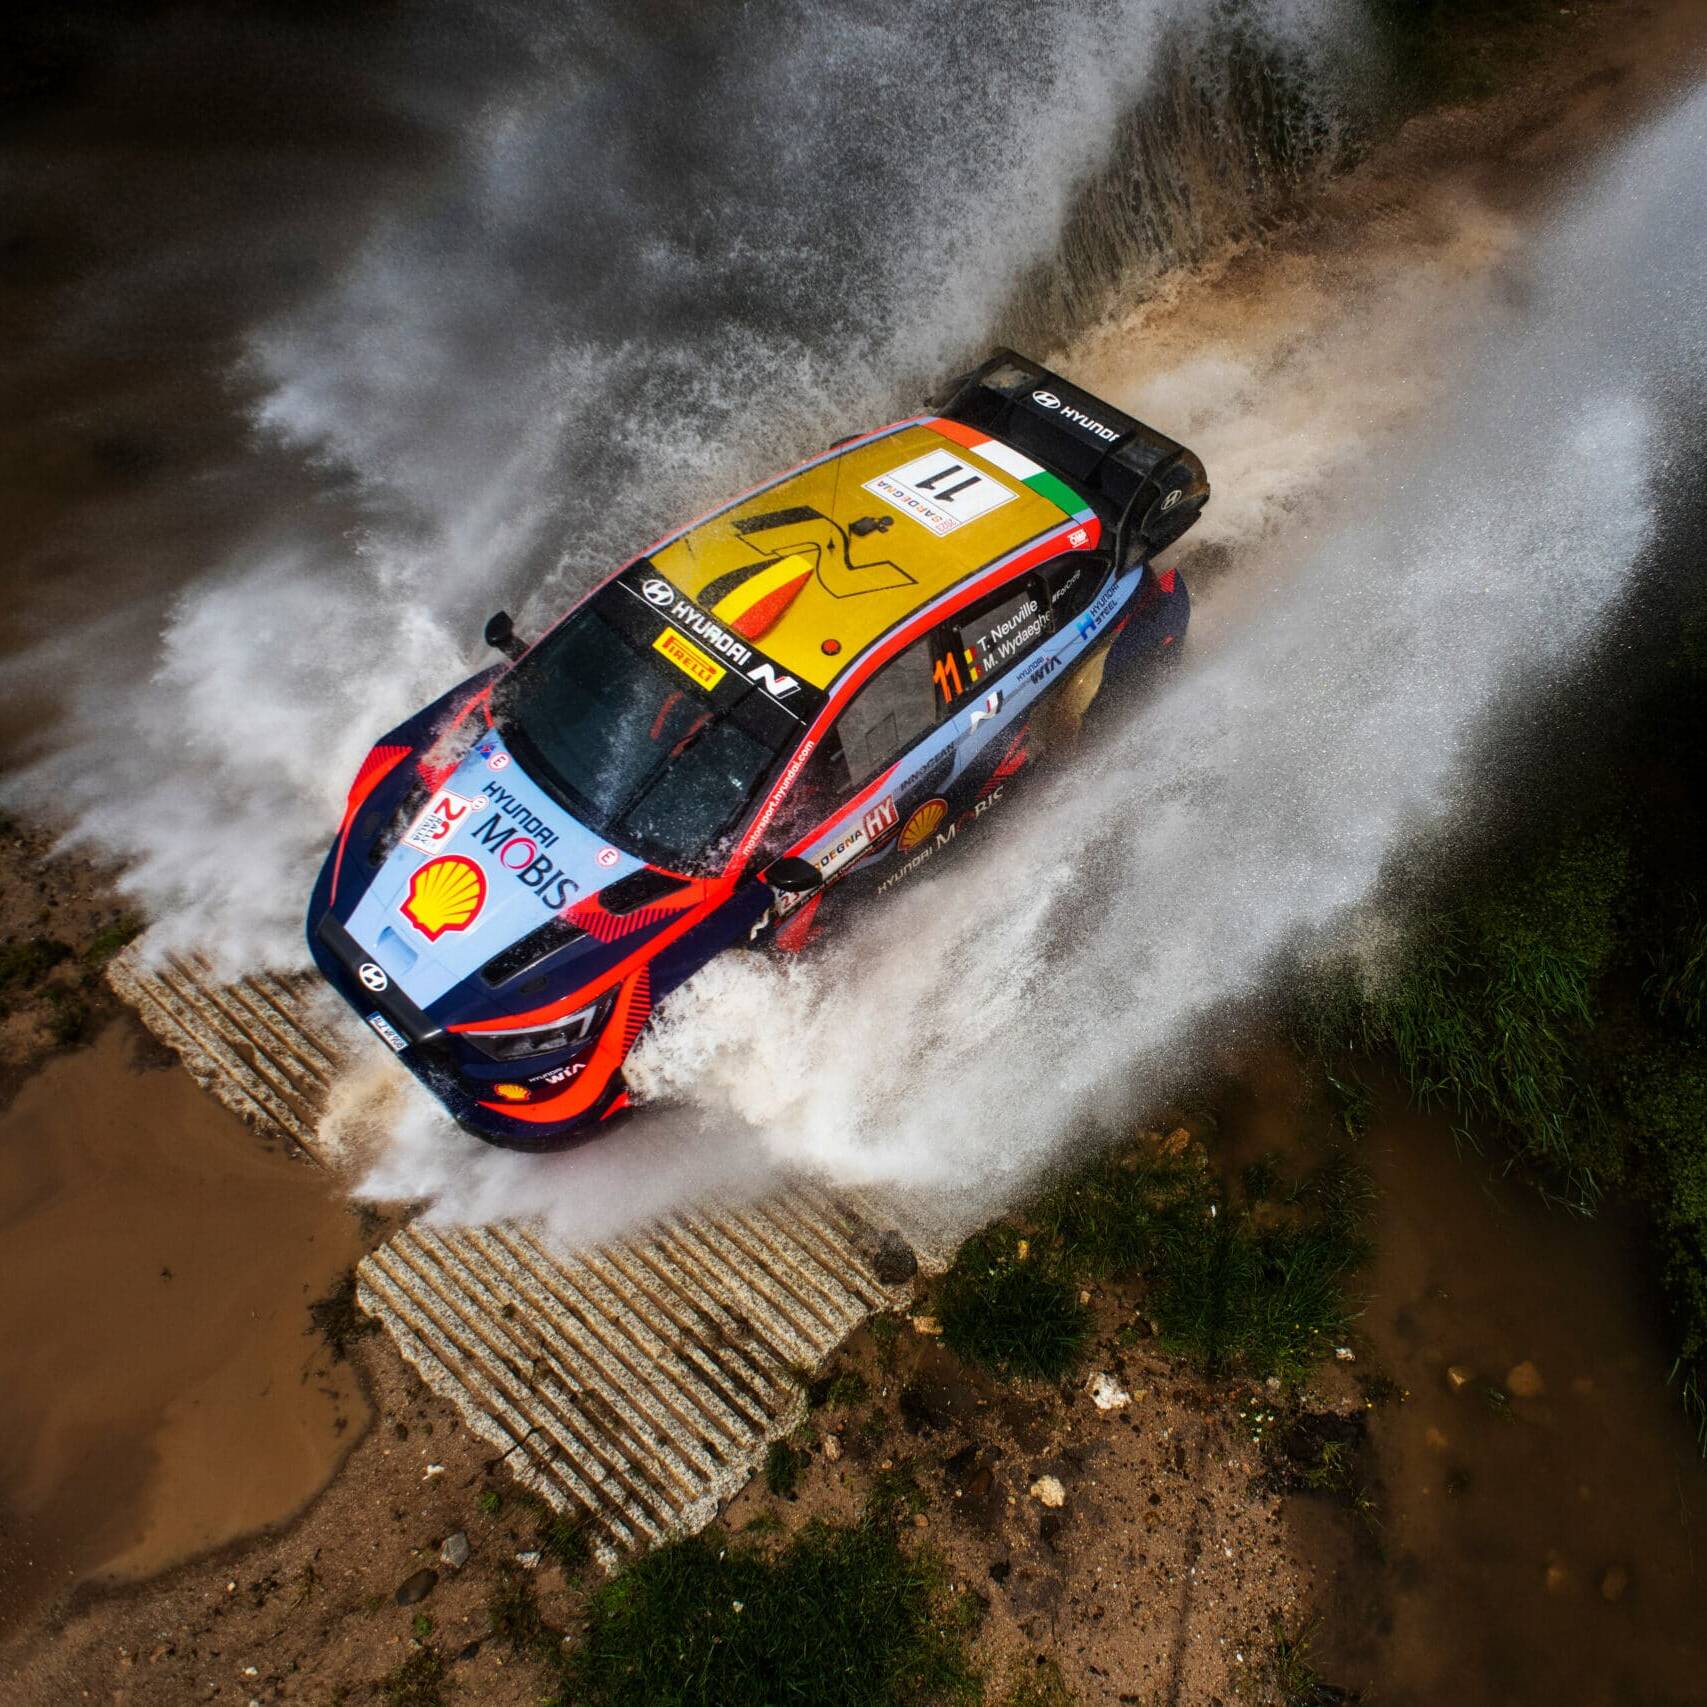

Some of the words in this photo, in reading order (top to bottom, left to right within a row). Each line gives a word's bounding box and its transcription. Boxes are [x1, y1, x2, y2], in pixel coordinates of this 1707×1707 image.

[1060, 406, 1120, 442] HYUND
[877, 480, 943, 523] SARDEGNA
[915, 465, 982, 502] 11
[1090, 583, 1119, 617] HYUNDAI
[1096, 600, 1118, 625] STEEL
[671, 601, 752, 666] HYUNDAI
[977, 636, 991, 652] T.
[990, 600, 1038, 643] Neuville
[662, 635, 718, 683] PIRELLI
[933, 651, 963, 704] 11
[982, 653, 998, 672] M.
[1016, 655, 1046, 682] HYUNDAI
[1031, 655, 1062, 684] WIA
[482, 780, 560, 849] HYUNDAI
[743, 740, 815, 856] motorsport.hyundai.com
[864, 796, 893, 838] HY
[470, 812, 579, 910] MOBIS
[878, 846, 933, 894] HYUNDAI
